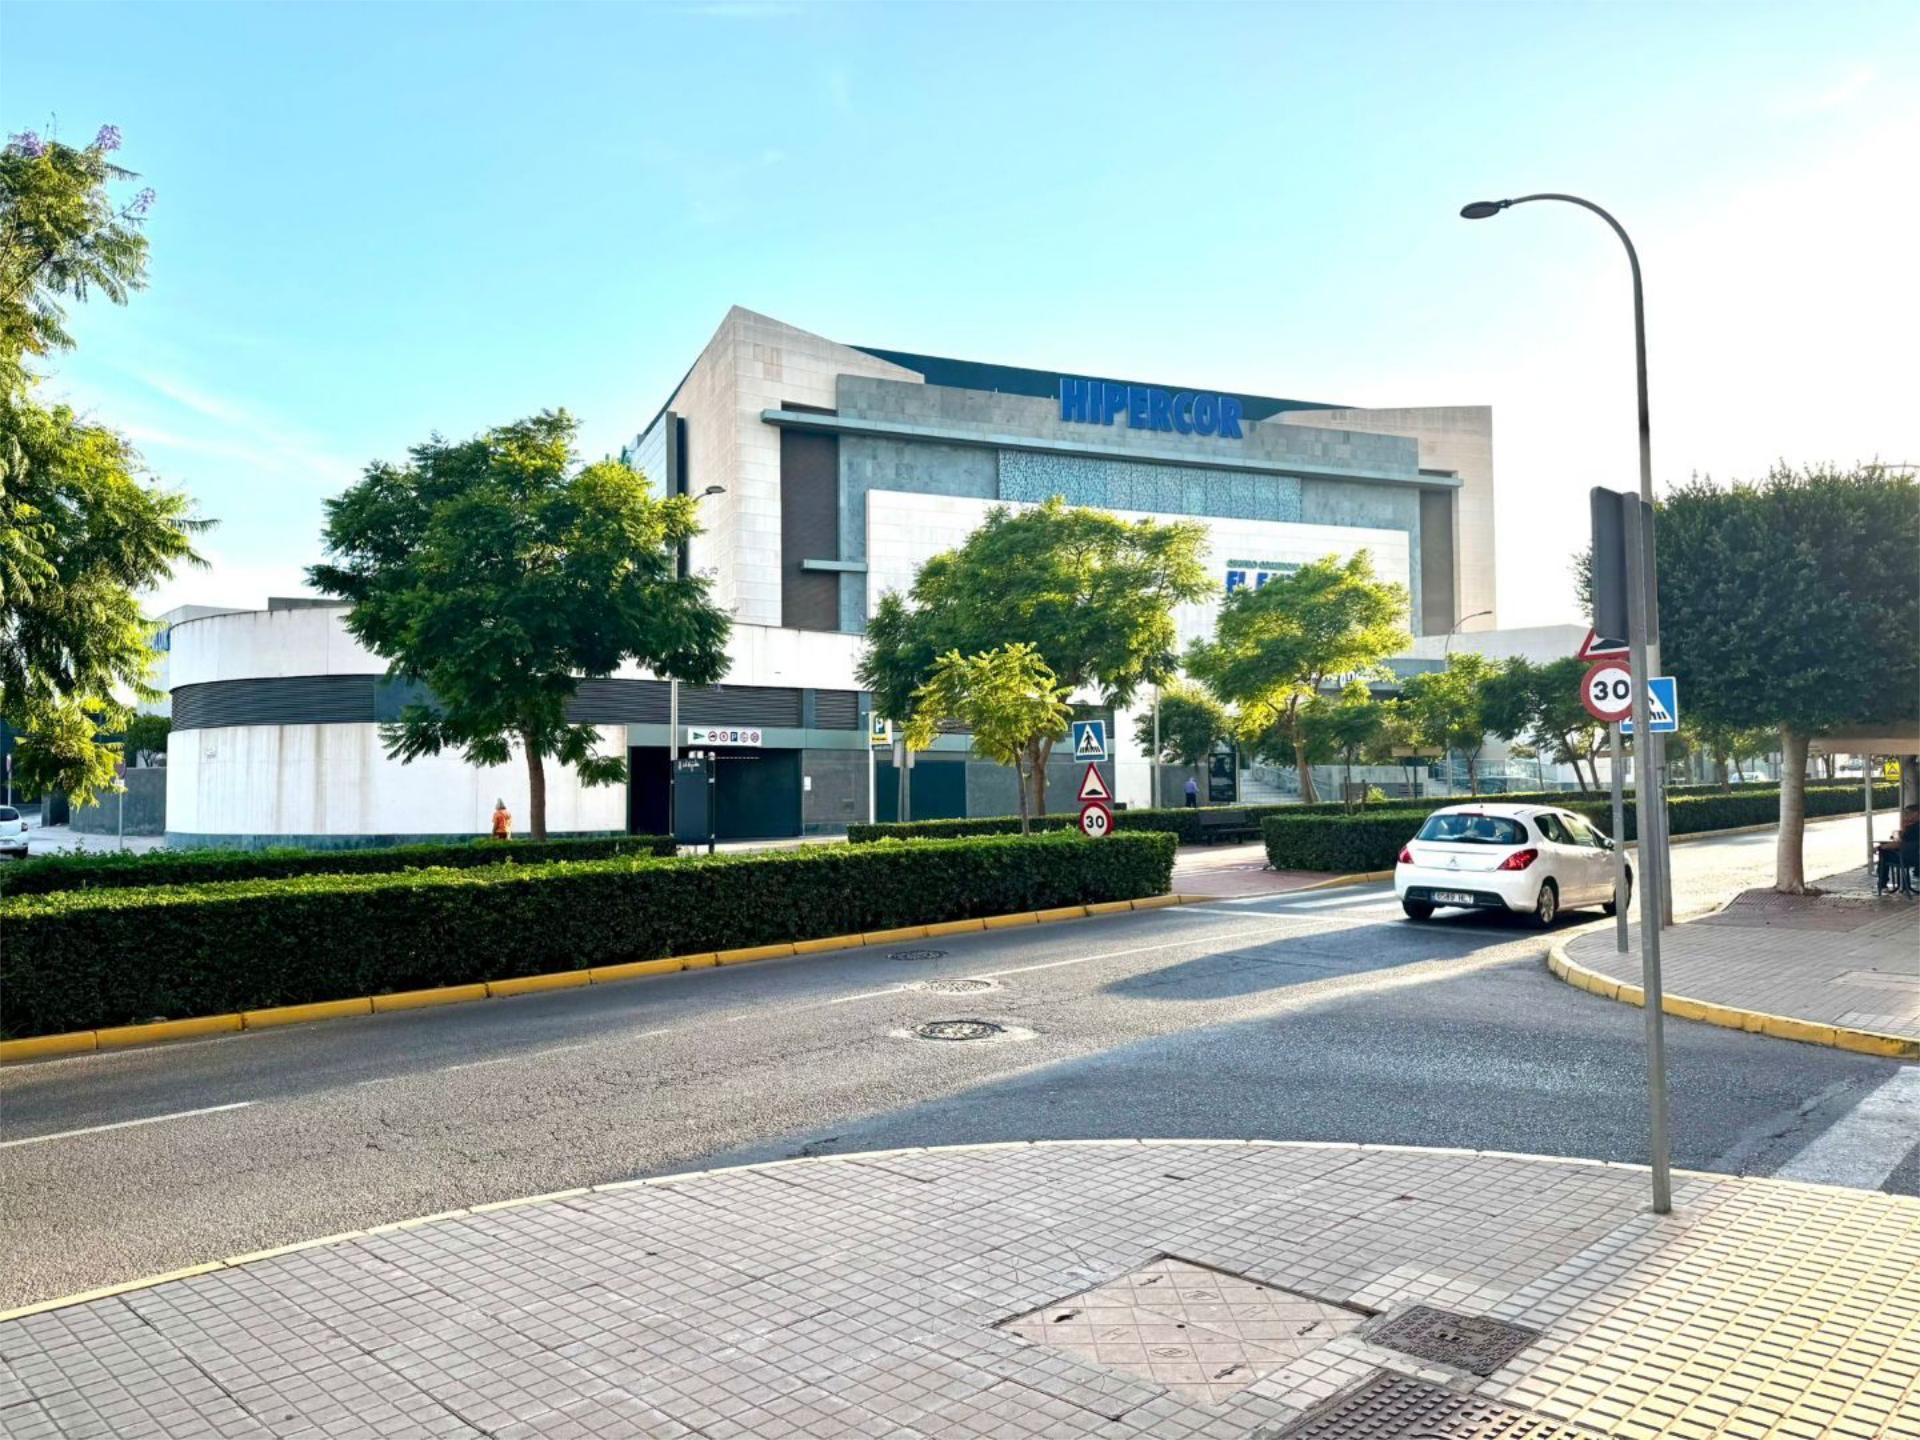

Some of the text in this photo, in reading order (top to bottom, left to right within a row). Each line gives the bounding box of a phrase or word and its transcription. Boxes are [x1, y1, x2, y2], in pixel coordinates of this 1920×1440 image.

[1060, 377, 1243, 439] HIPERCOR
[1593, 679, 1630, 701] 30
[876, 717, 884, 733] P
[1086, 815, 1105, 829] 30
